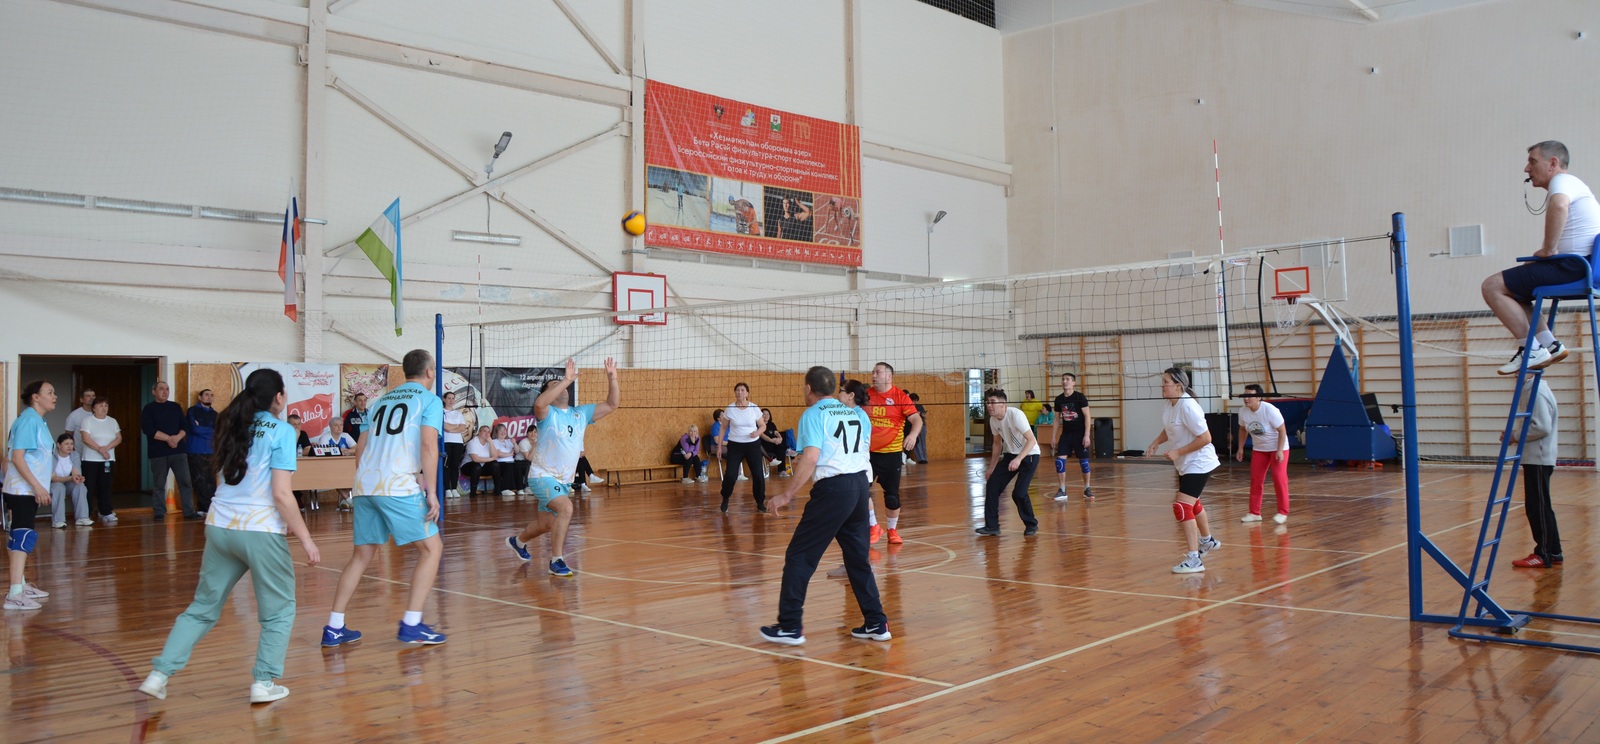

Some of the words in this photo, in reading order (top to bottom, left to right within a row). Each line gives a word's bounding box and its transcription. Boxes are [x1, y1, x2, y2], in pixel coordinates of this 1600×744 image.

[678, 145, 728, 163] Всероссийский
[729, 155, 809, 177] физкультурно-спортивный
[811, 171, 838, 180] комплекс
[732, 144, 791, 164] физкультура-спорт
[792, 156, 825, 168] комплексы
[749, 169, 766, 180] труду
[372, 403, 408, 436] 10
[873, 406, 886, 416] 80
[568, 425, 573, 437] 9
[834, 420, 861, 454] 17
